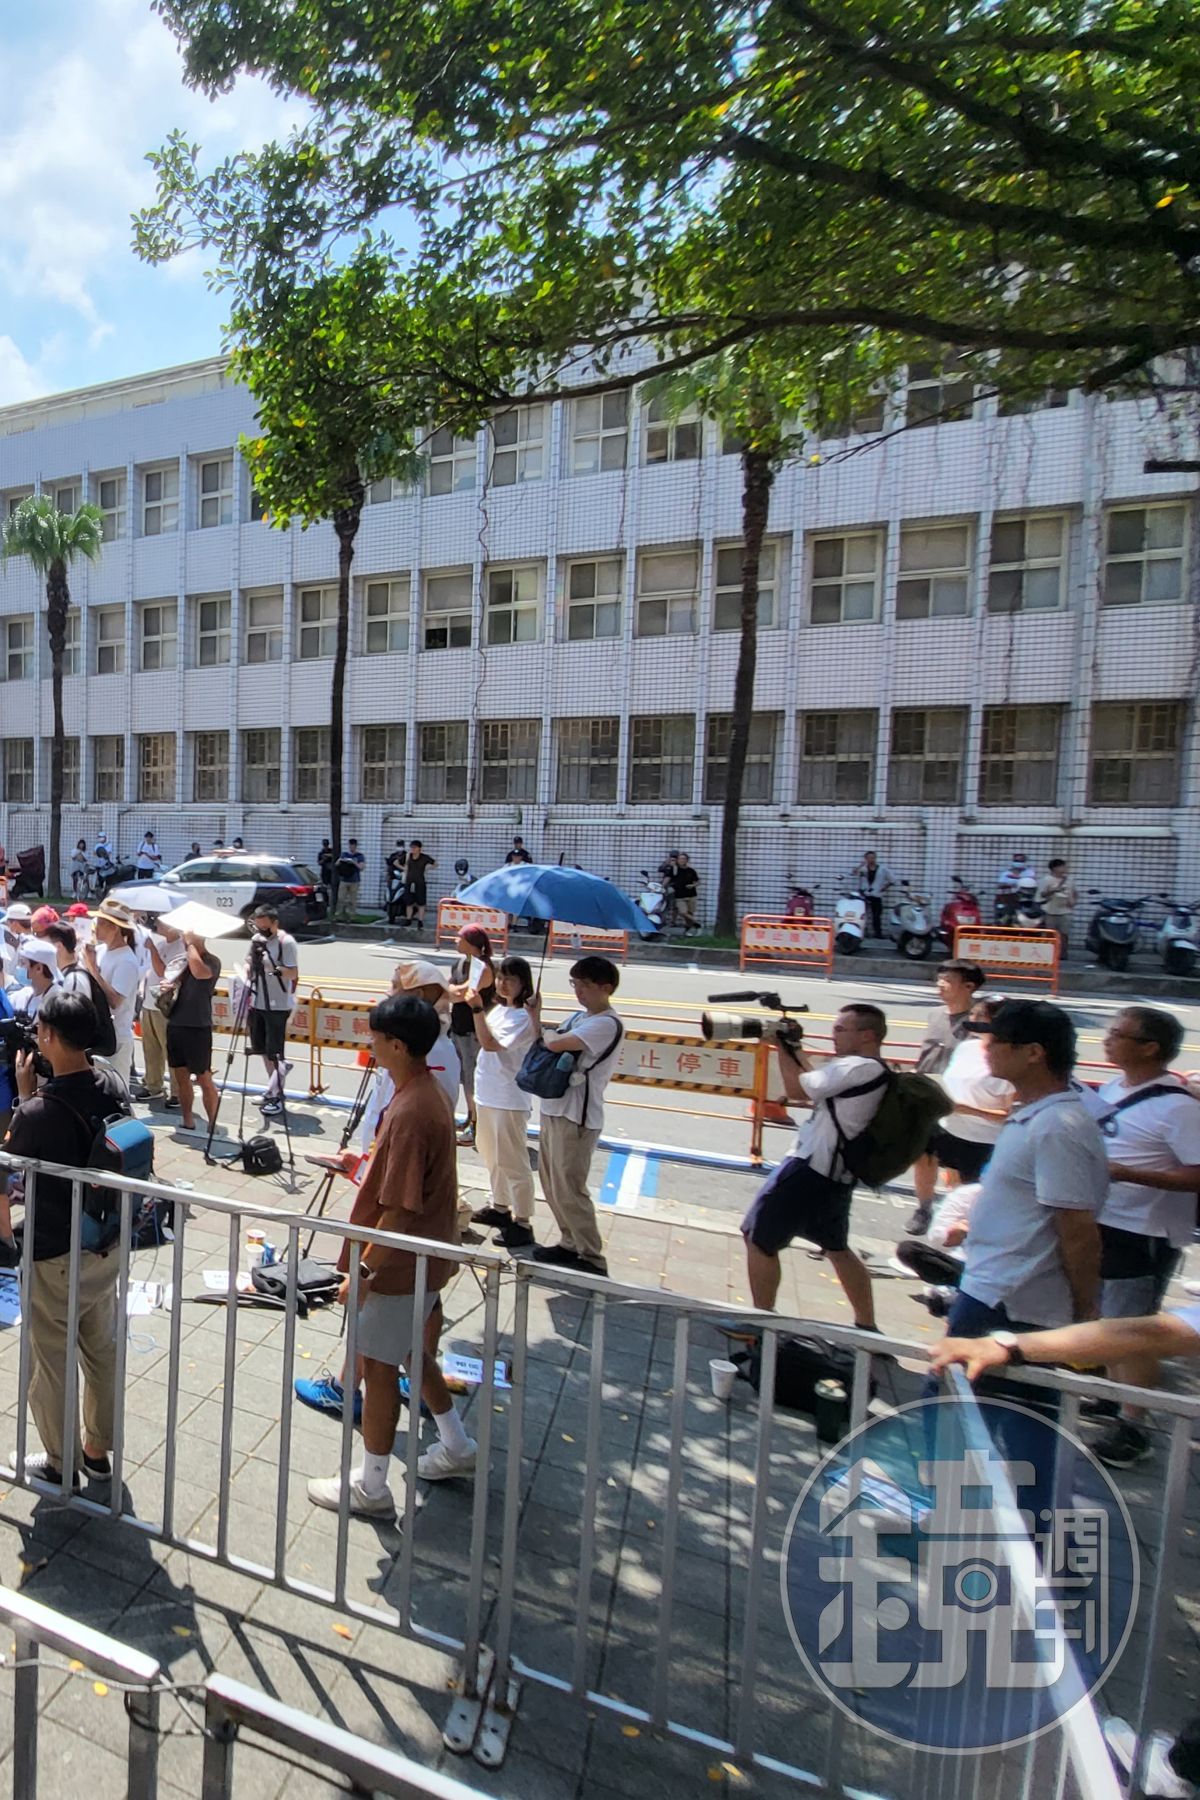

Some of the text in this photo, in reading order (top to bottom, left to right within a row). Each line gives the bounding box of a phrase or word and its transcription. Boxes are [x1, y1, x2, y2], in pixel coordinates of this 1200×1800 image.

[216, 897, 234, 907] 023
[617, 1049, 743, 1079] 止停車
